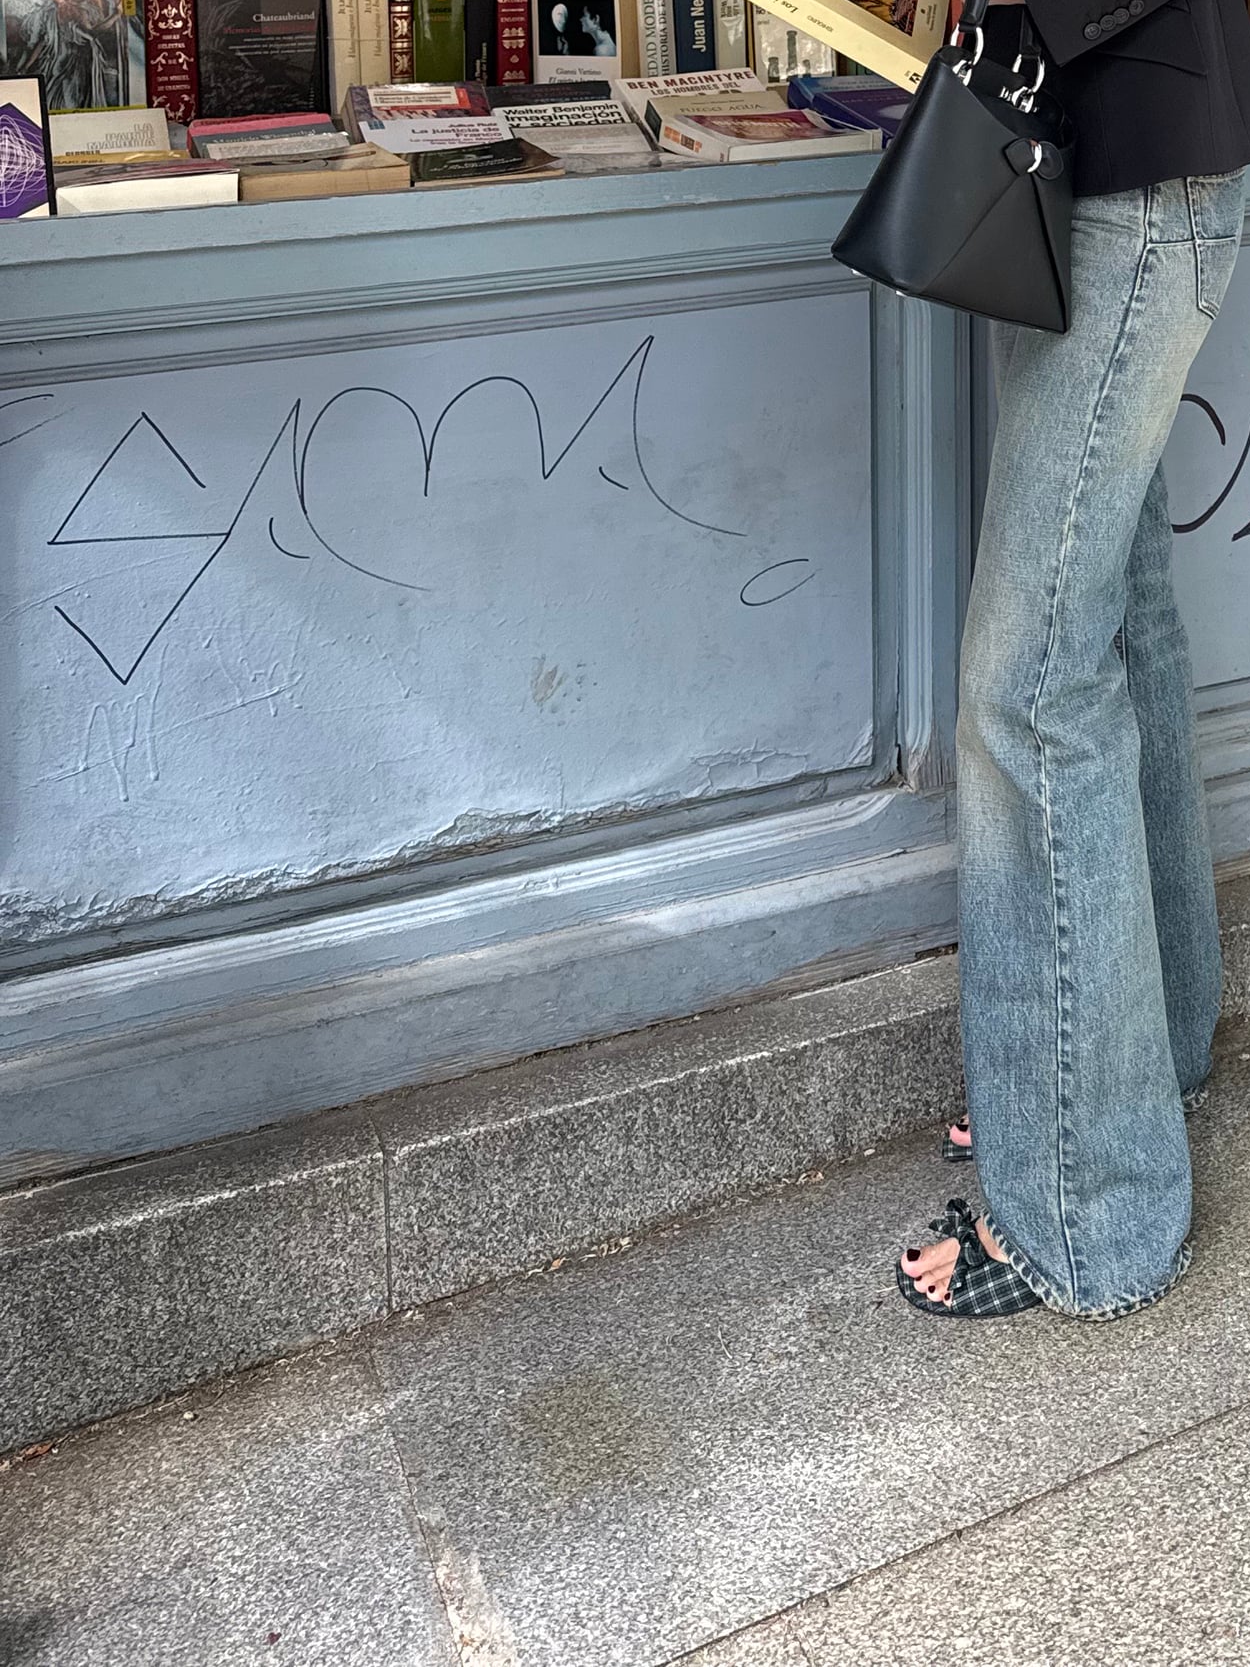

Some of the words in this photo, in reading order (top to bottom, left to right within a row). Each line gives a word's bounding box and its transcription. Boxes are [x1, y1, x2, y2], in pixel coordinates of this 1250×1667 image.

[252, 12, 315, 24] Chateaubriand
[691, 19, 707, 53] Juan
[647, 41, 660, 78] EDAD
[627, 79, 659, 90] BEN
[664, 71, 756, 88] MACINTYRE
[651, 88, 672, 96] LOS
[674, 84, 721, 94] HOMBRES
[722, 82, 741, 91] DEL
[501, 107, 549, 116] Walter
[551, 103, 619, 114] Benjamin
[504, 109, 623, 123] Imaginación
